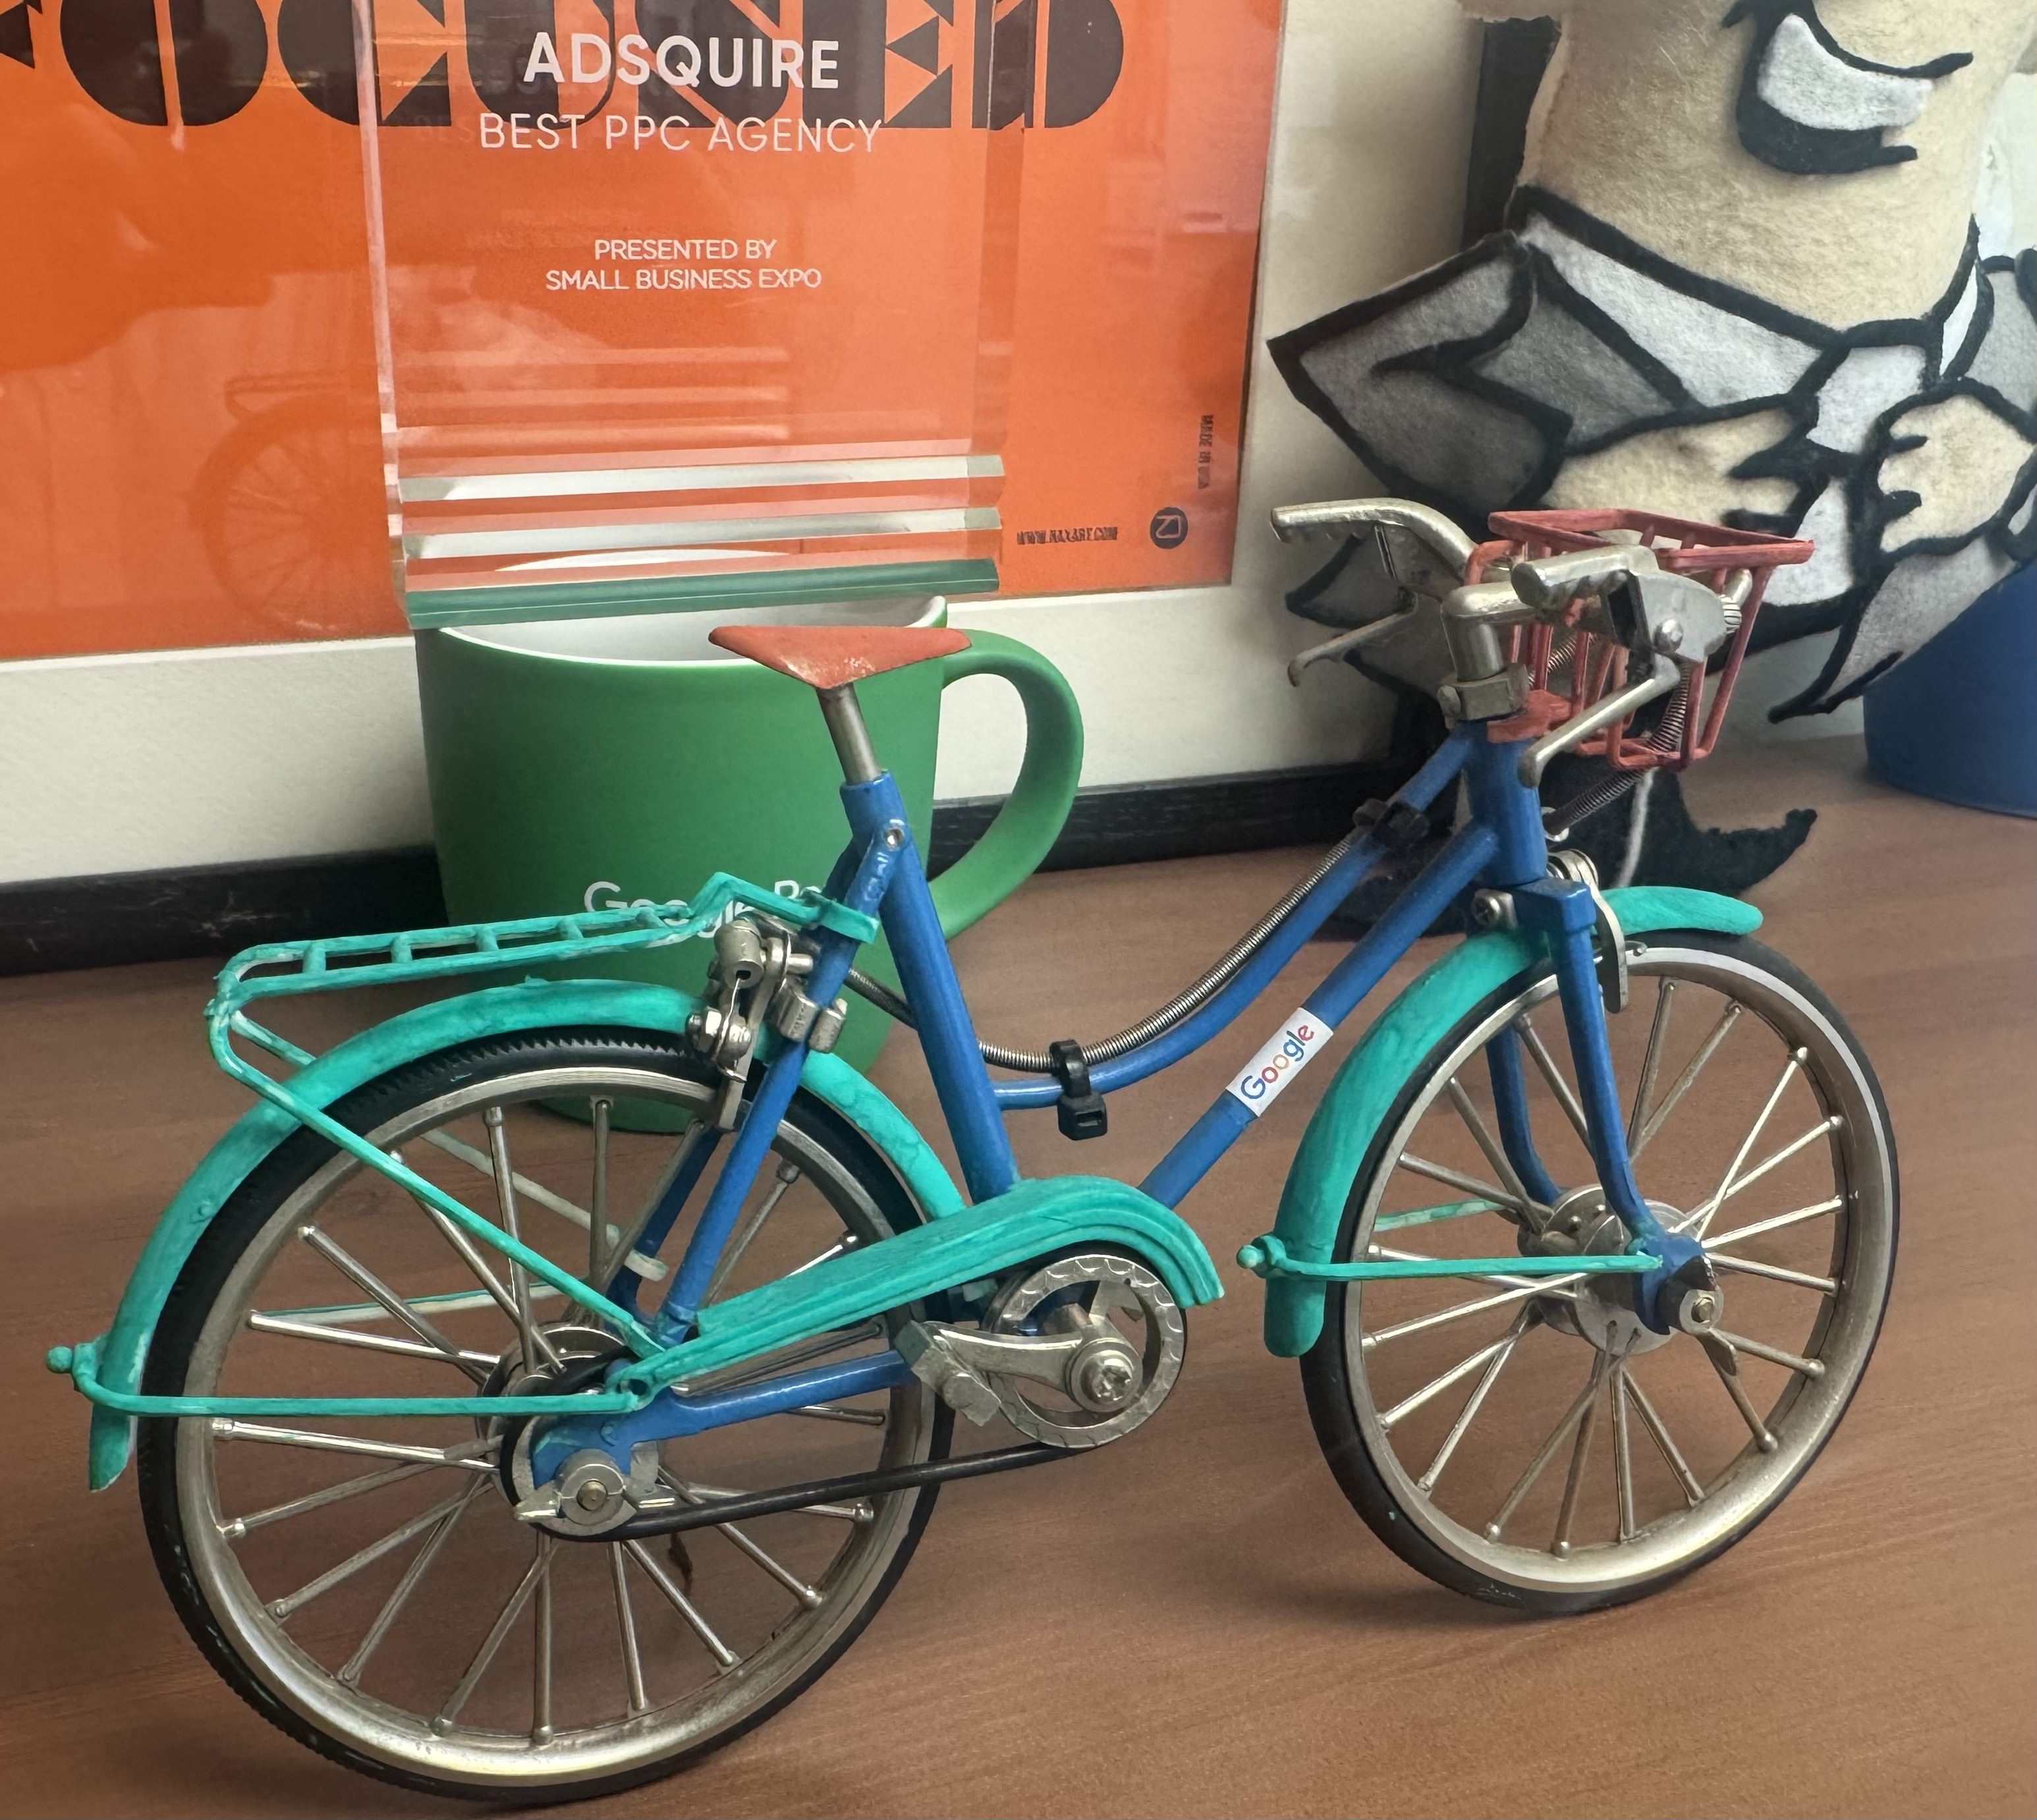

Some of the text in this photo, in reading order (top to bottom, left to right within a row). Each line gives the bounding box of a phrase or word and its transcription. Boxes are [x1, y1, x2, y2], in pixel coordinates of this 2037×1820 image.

[522, 31, 839, 89] ADSQUIRE
[479, 113, 886, 153] BEST PPC AGENCY
[594, 238, 777, 261] PRESENTED BY
[545, 268, 822, 292] SMALL BUSINESS EXPO
[1240, 1024, 1315, 1099] Google
